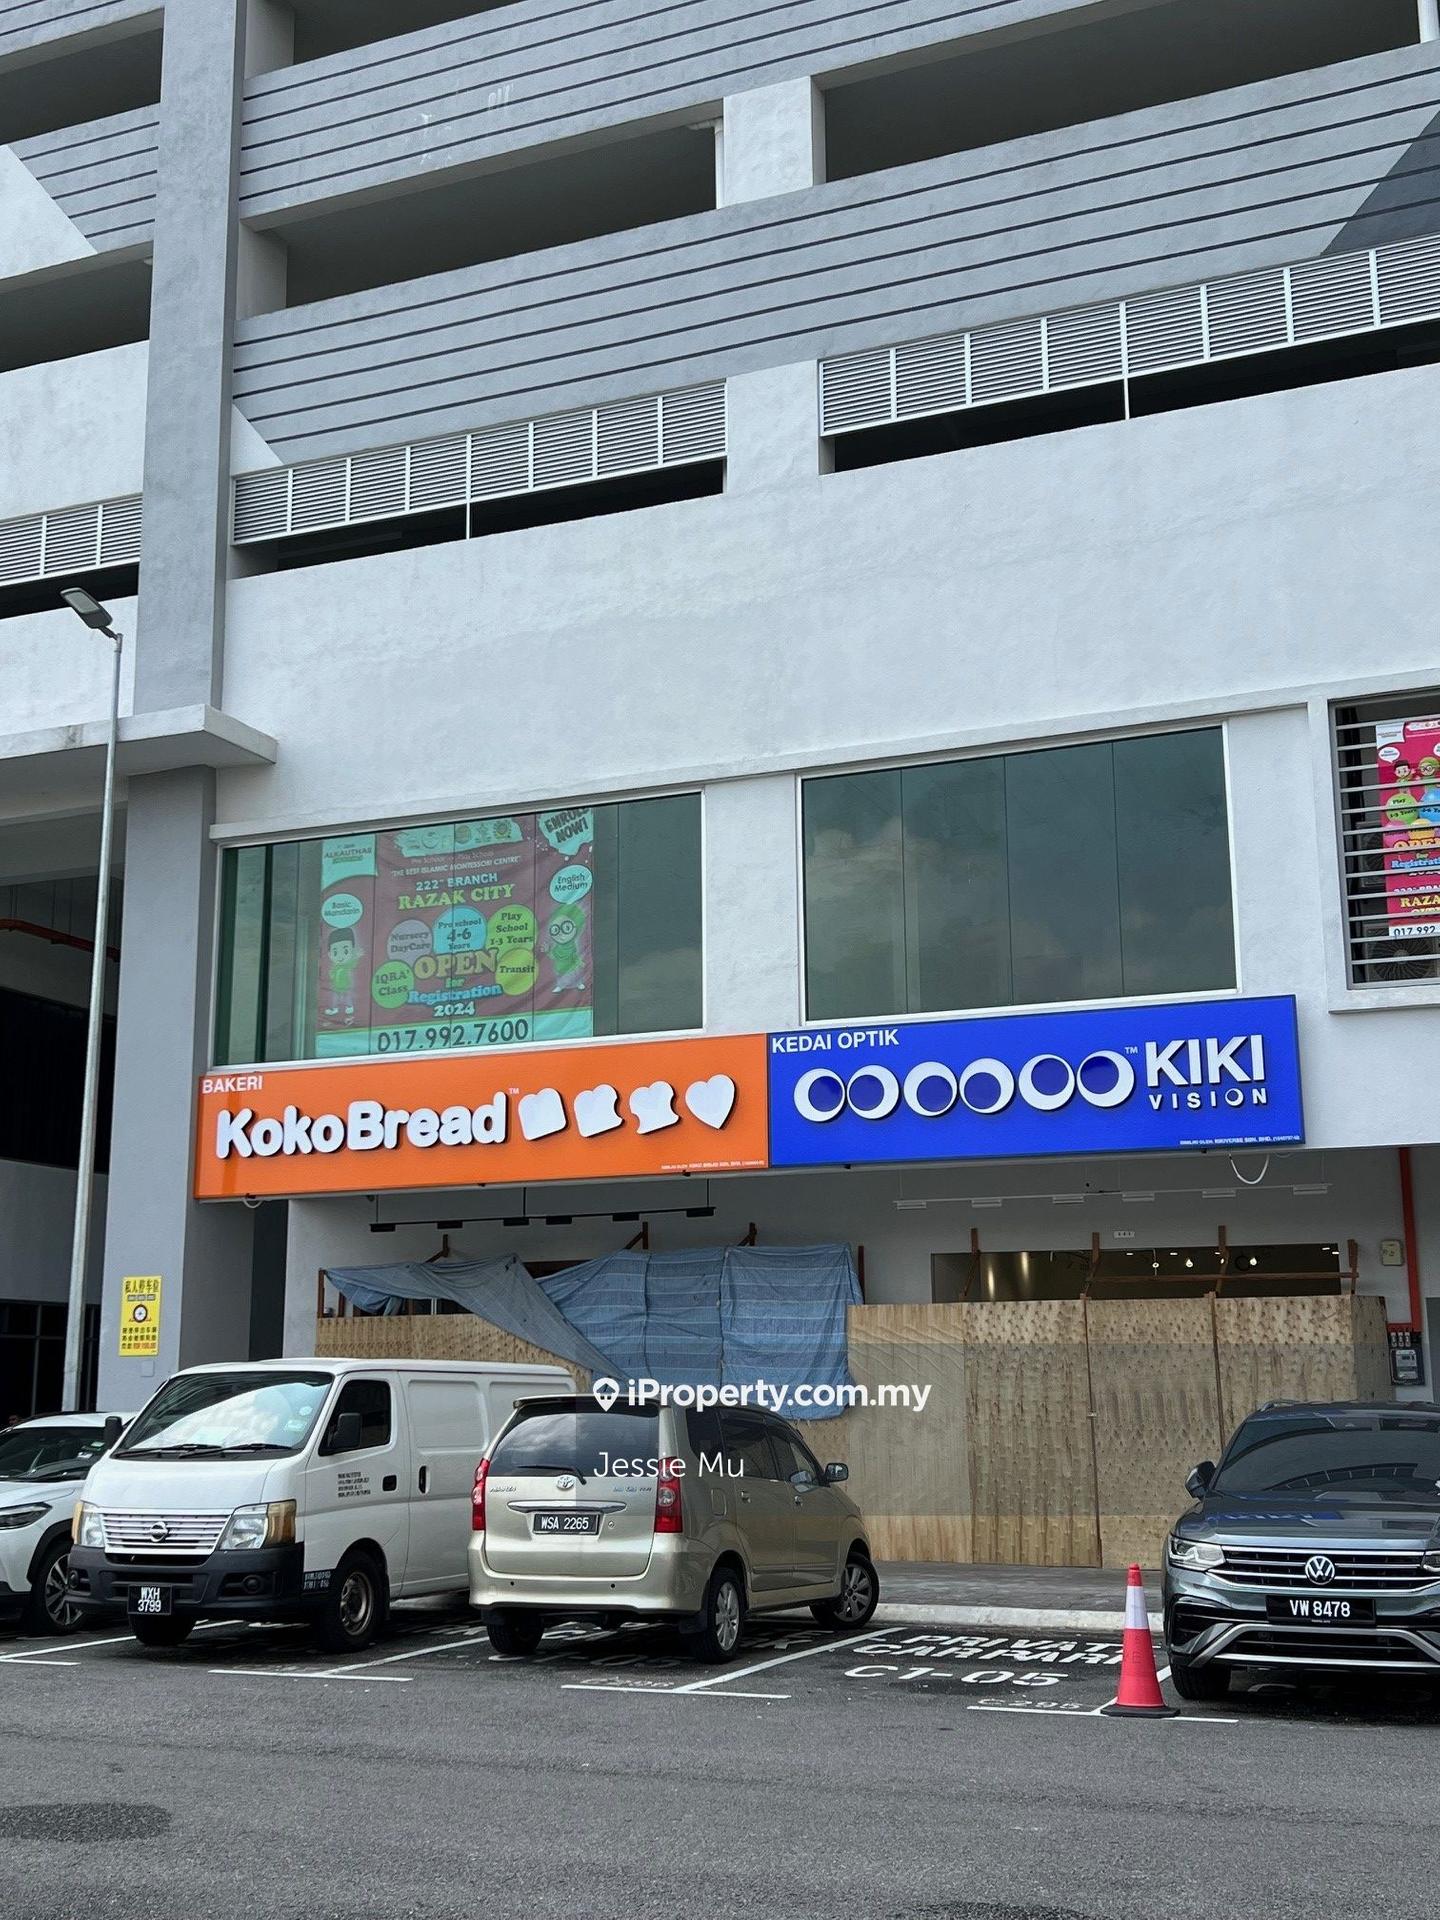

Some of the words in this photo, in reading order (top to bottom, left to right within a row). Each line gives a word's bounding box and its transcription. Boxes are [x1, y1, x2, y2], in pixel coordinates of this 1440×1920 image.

[447, 872, 498, 887] BRANCH
[554, 882, 588, 892] Medium
[557, 873, 585, 885] English
[398, 889, 466, 910] RAZAK
[471, 883, 516, 902] CITY
[501, 912, 522, 921] Play
[496, 923, 528, 932] School
[506, 935, 535, 944] Years
[414, 948, 500, 980] OPEN
[500, 966, 535, 974] Transit
[378, 984, 408, 996] Class
[408, 984, 503, 1006] Registration
[433, 1001, 476, 1017] 2024
[378, 1018, 529, 1052] 017.992.7600
[772, 1034, 832, 1053] KEDAI
[837, 1029, 899, 1049] OPTIK
[1145, 1034, 1265, 1087] KIKI
[202, 1075, 264, 1095] BAKERI
[1149, 1088, 1268, 1110] VISION
[215, 1091, 509, 1160] KokoBread
[541, 1517, 559, 1529] WSA
[563, 1517, 589, 1530] 2265
[141, 1586, 160, 1600] WXH
[138, 1599, 161, 1612] 3799
[1290, 1600, 1309, 1616] VW
[1313, 1601, 1351, 1617] 8478
[901, 1634, 1160, 1652] PRIVAT
[844, 1665, 1068, 1686] C1-05
